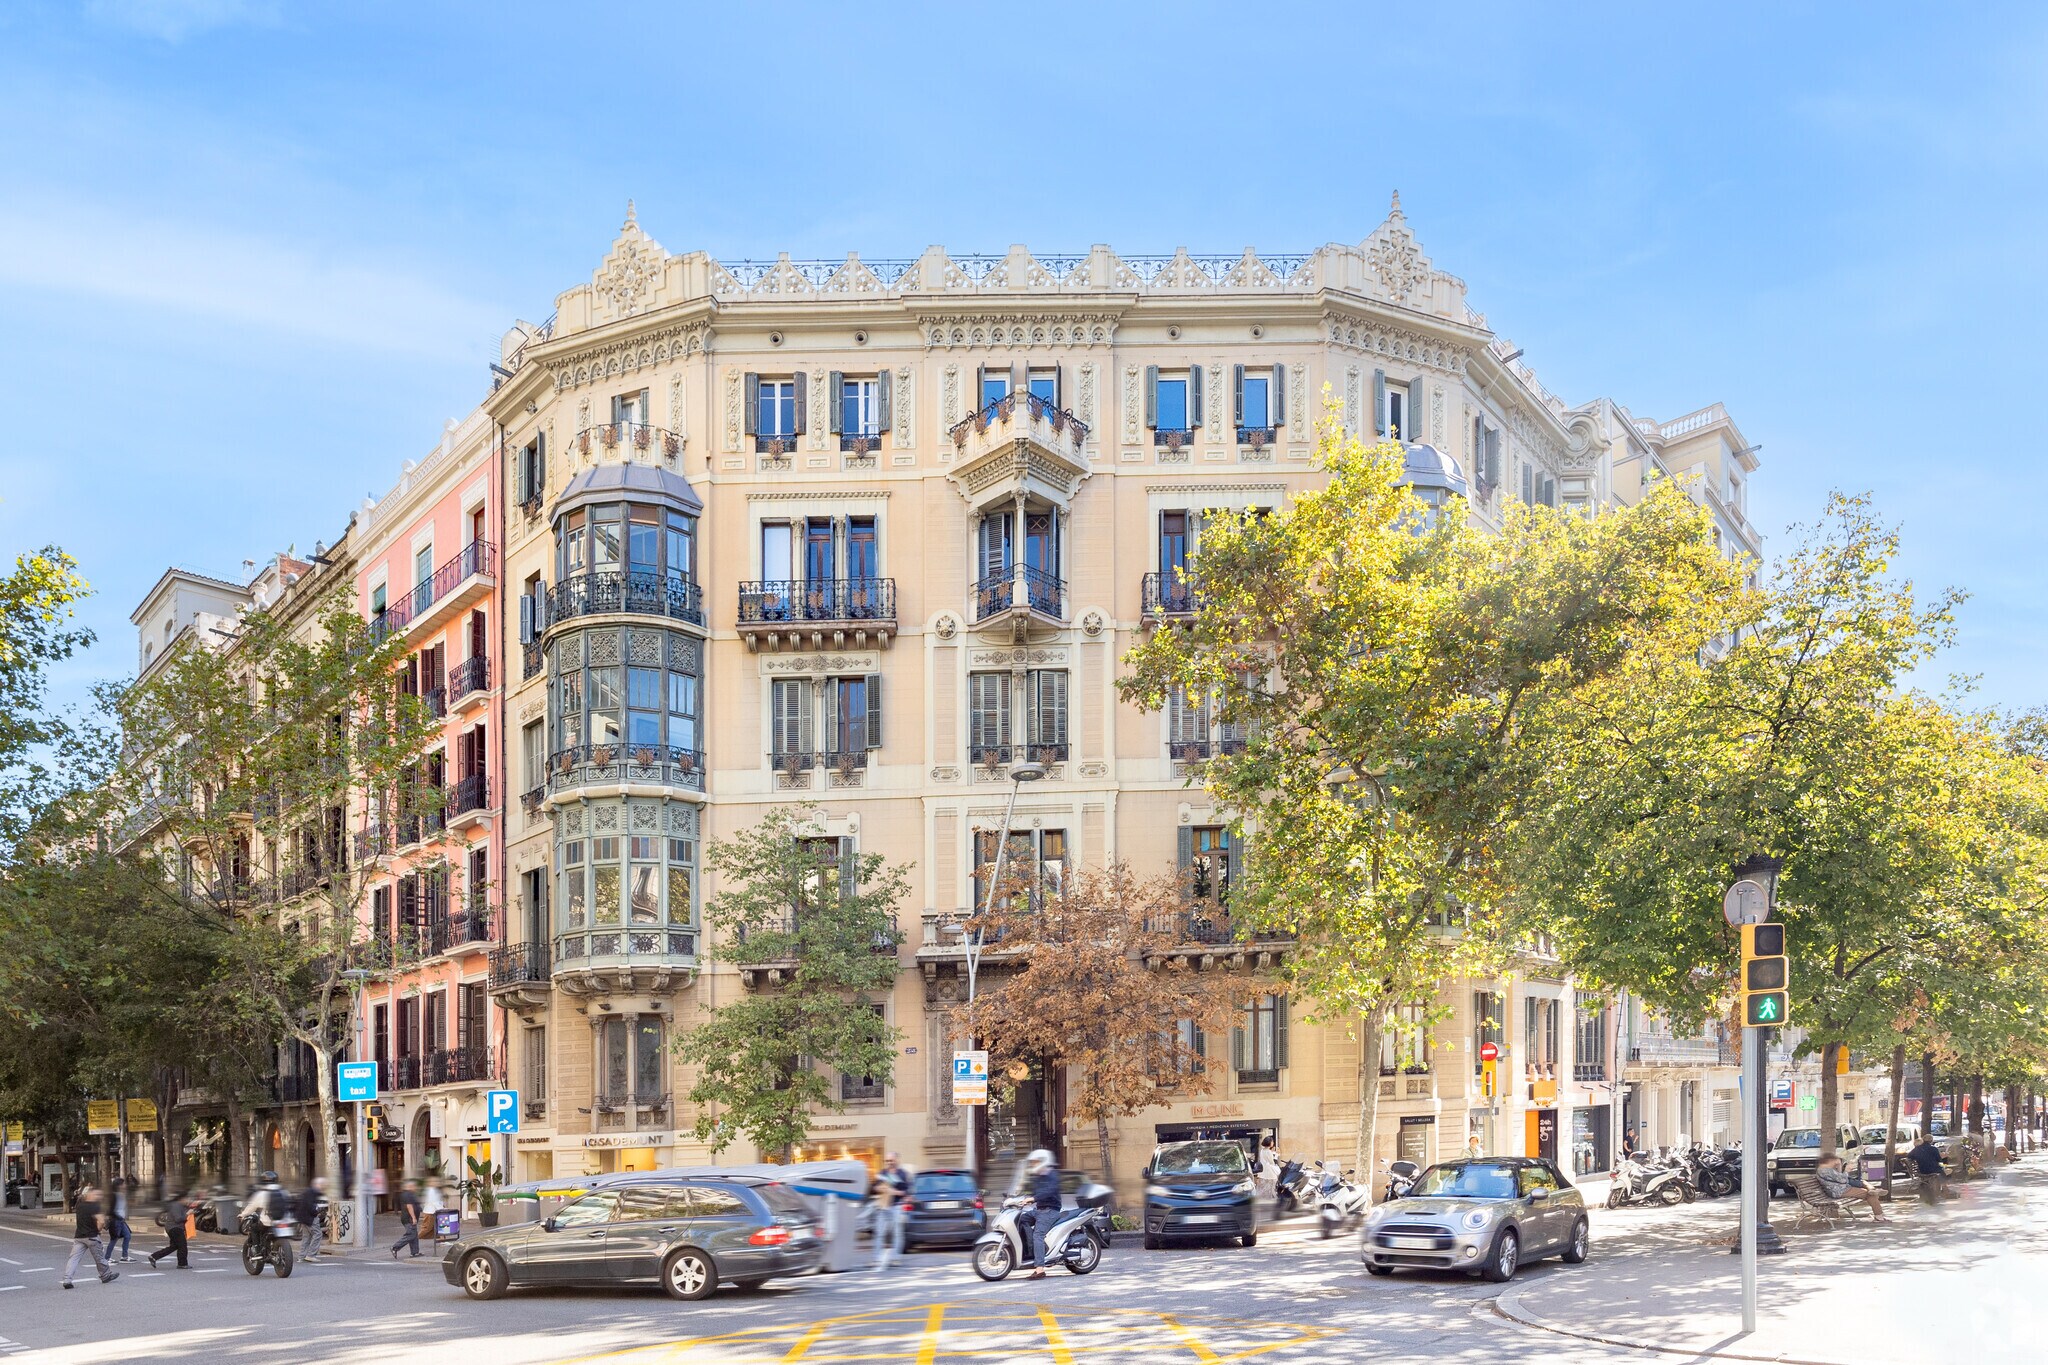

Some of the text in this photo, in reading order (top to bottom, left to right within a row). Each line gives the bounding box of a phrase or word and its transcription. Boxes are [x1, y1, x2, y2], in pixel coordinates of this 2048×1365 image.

[957, 1061, 967, 1073] P
[350, 1086, 366, 1095] taxi
[1773, 1080, 1790, 1097] P
[493, 1093, 513, 1117] P
[1207, 1103, 1244, 1115] CLINIC
